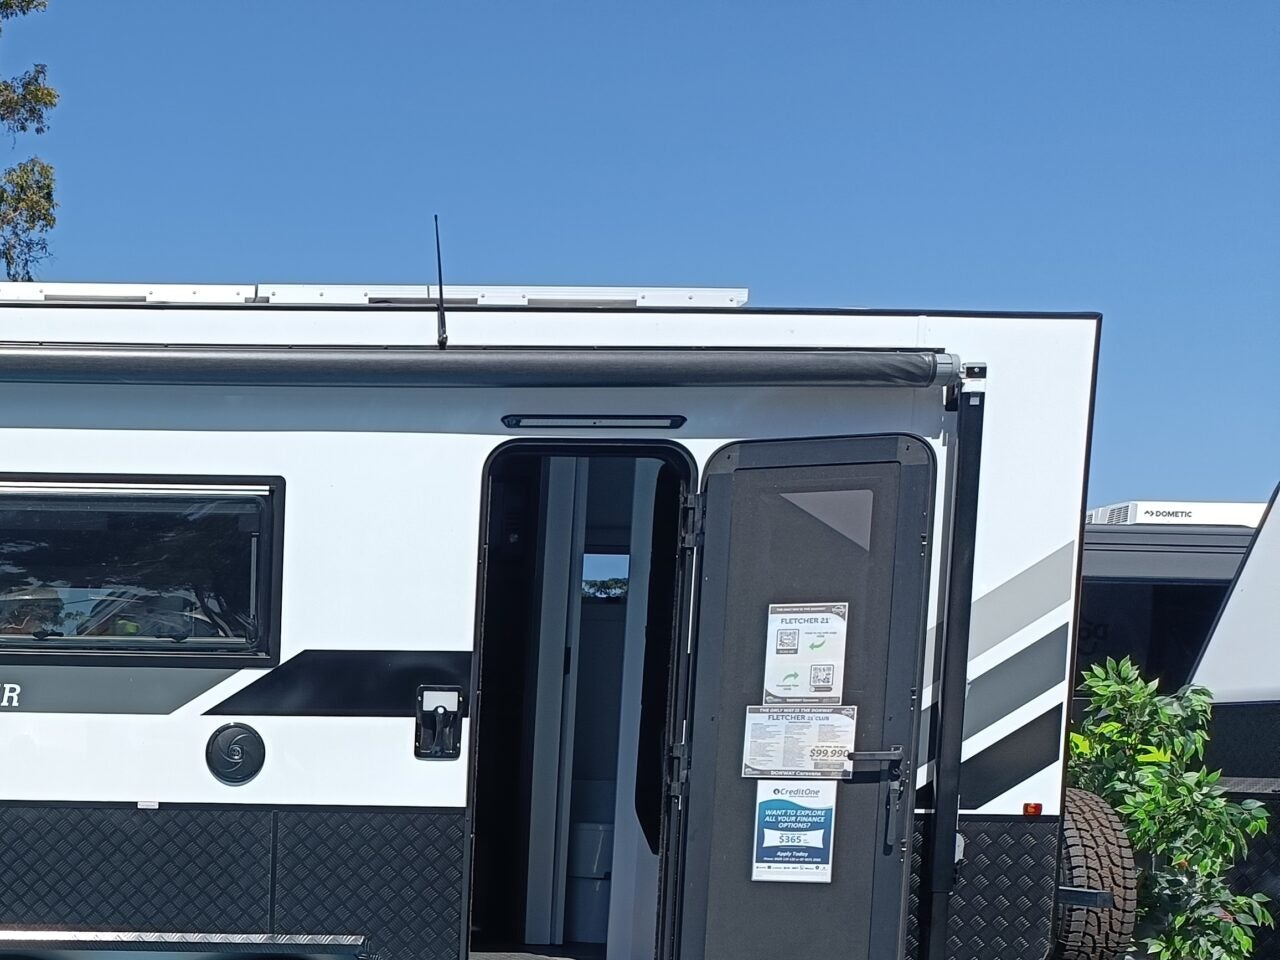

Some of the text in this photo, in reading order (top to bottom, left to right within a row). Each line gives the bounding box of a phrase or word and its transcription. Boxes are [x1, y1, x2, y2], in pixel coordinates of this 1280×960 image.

[1155, 510, 1192, 518] DOMETIC
[780, 617, 819, 625] FLETCHER
[809, 748, 850, 758] $99,990
[780, 788, 820, 796] CreditOne
[778, 835, 802, 844] $365
